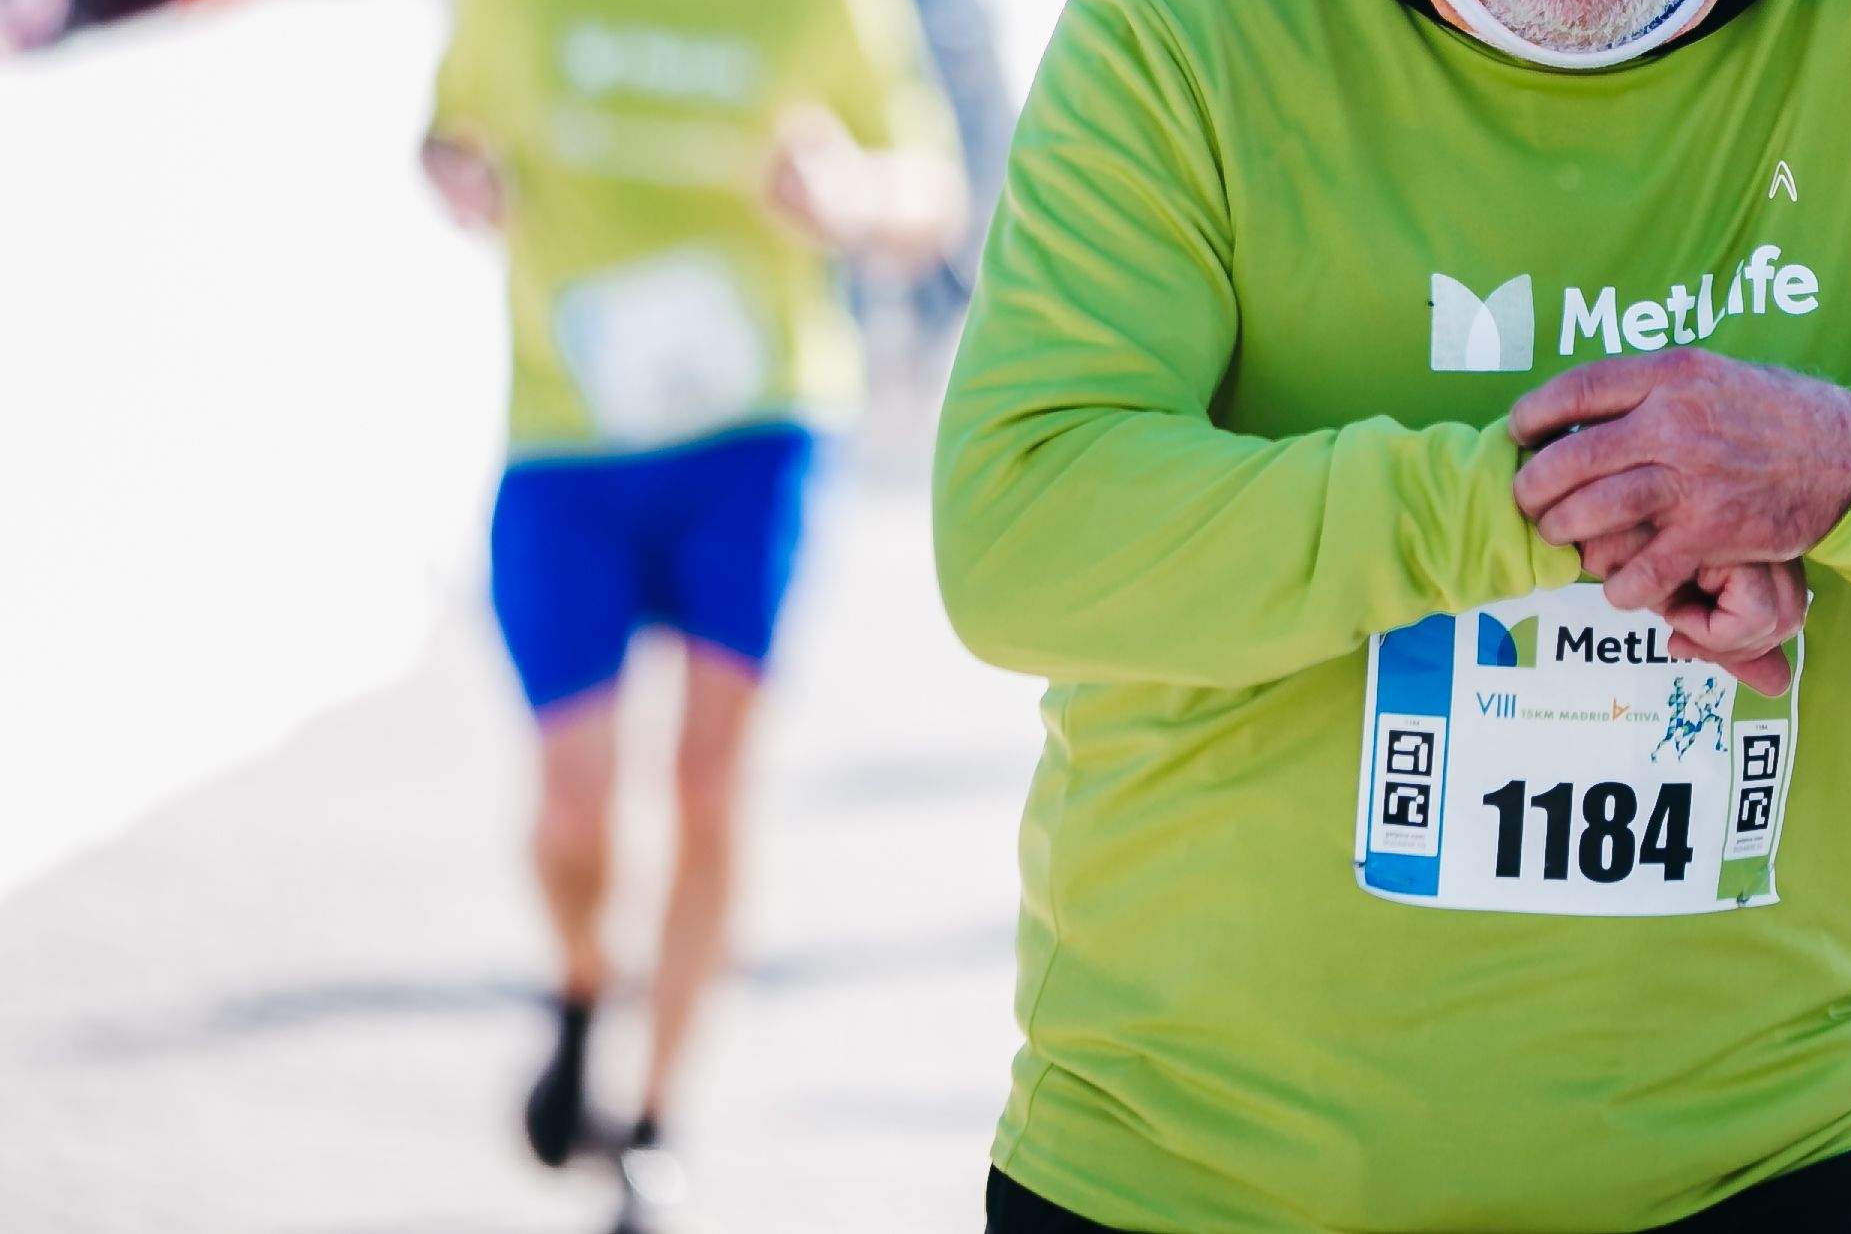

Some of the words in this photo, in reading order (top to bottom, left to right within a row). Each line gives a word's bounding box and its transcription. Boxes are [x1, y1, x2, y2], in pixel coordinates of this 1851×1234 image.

[1559, 244, 1820, 356] MetLife
[1556, 625, 1693, 665] MetL
[1476, 692, 1518, 719] VIII
[1483, 780, 1694, 883] 1184
